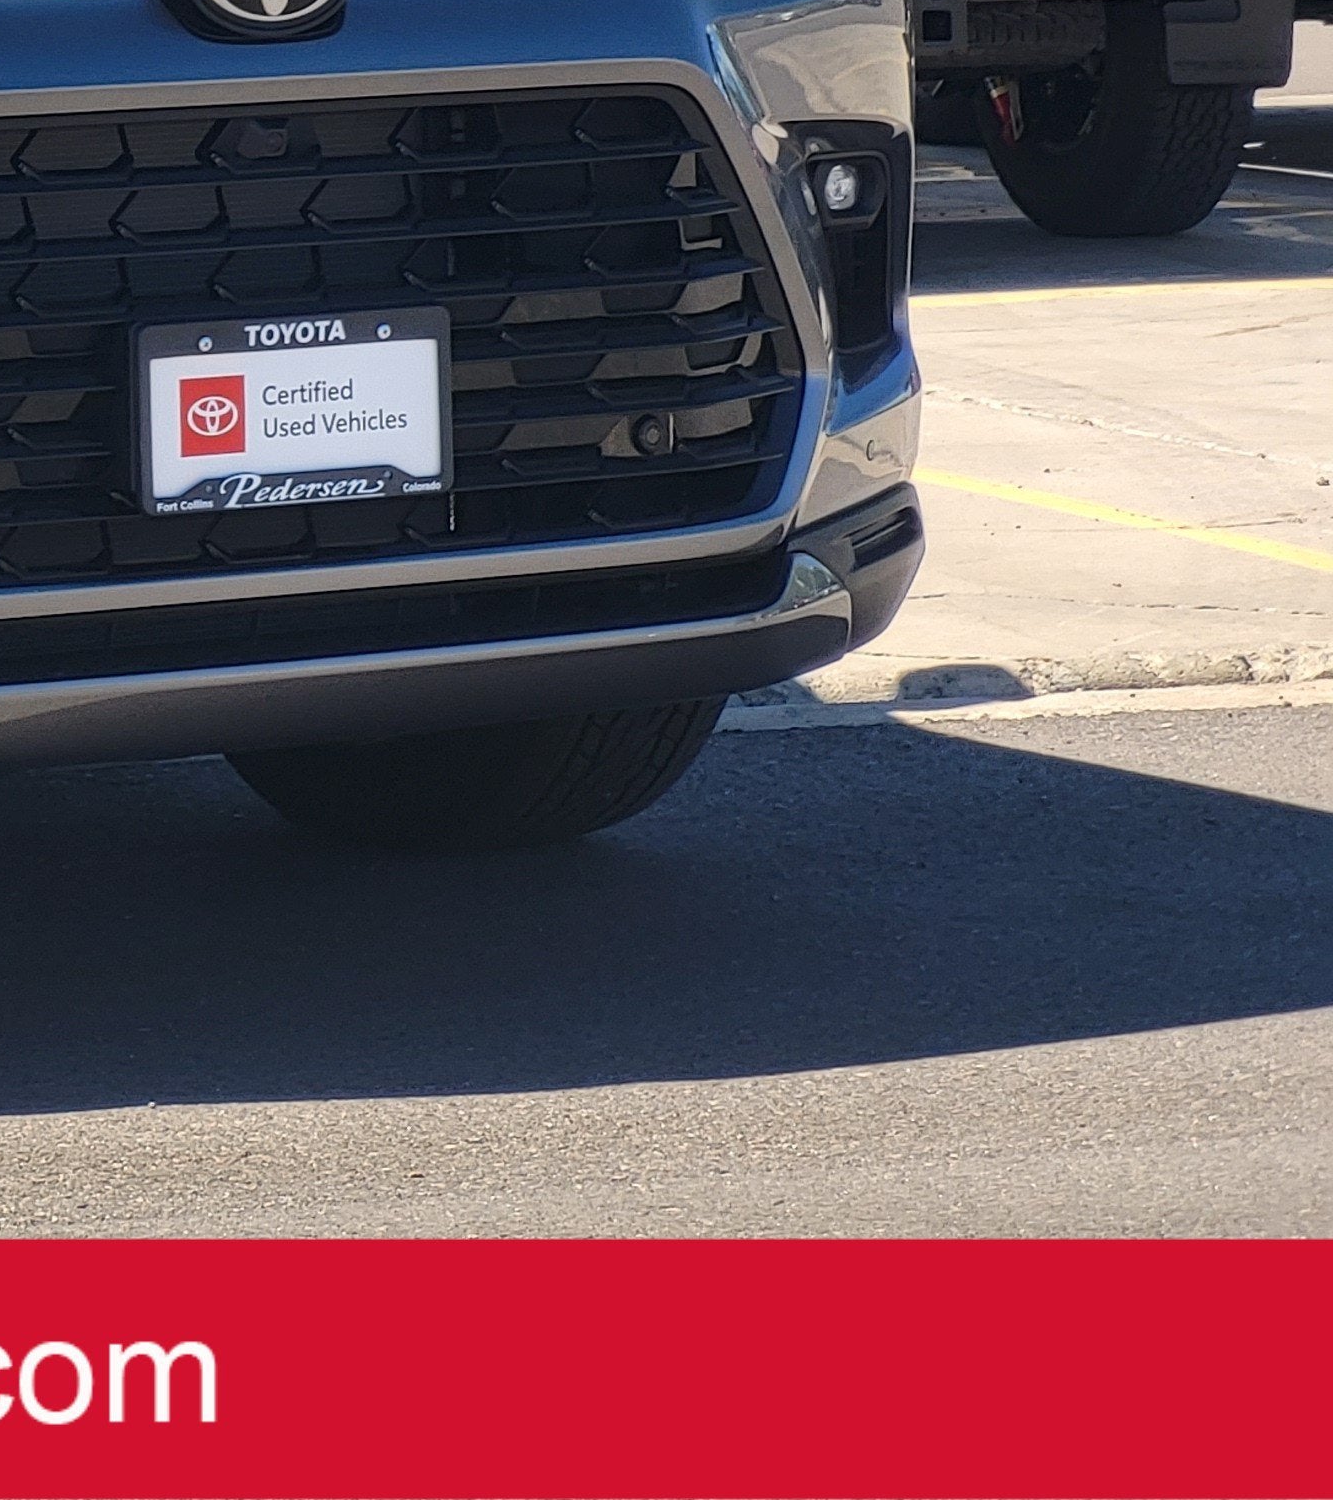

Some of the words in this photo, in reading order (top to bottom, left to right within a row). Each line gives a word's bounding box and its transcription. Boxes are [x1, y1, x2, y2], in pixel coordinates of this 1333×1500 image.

[244, 319, 347, 347] TOYOTA
[262, 378, 354, 406] Certified
[263, 415, 317, 438] Used
[322, 408, 408, 434] Vehicles
[219, 473, 385, 509] Pedersen
[402, 480, 442, 493] Colorado
[156, 501, 179, 513] Fort
[180, 498, 214, 512] Collins
